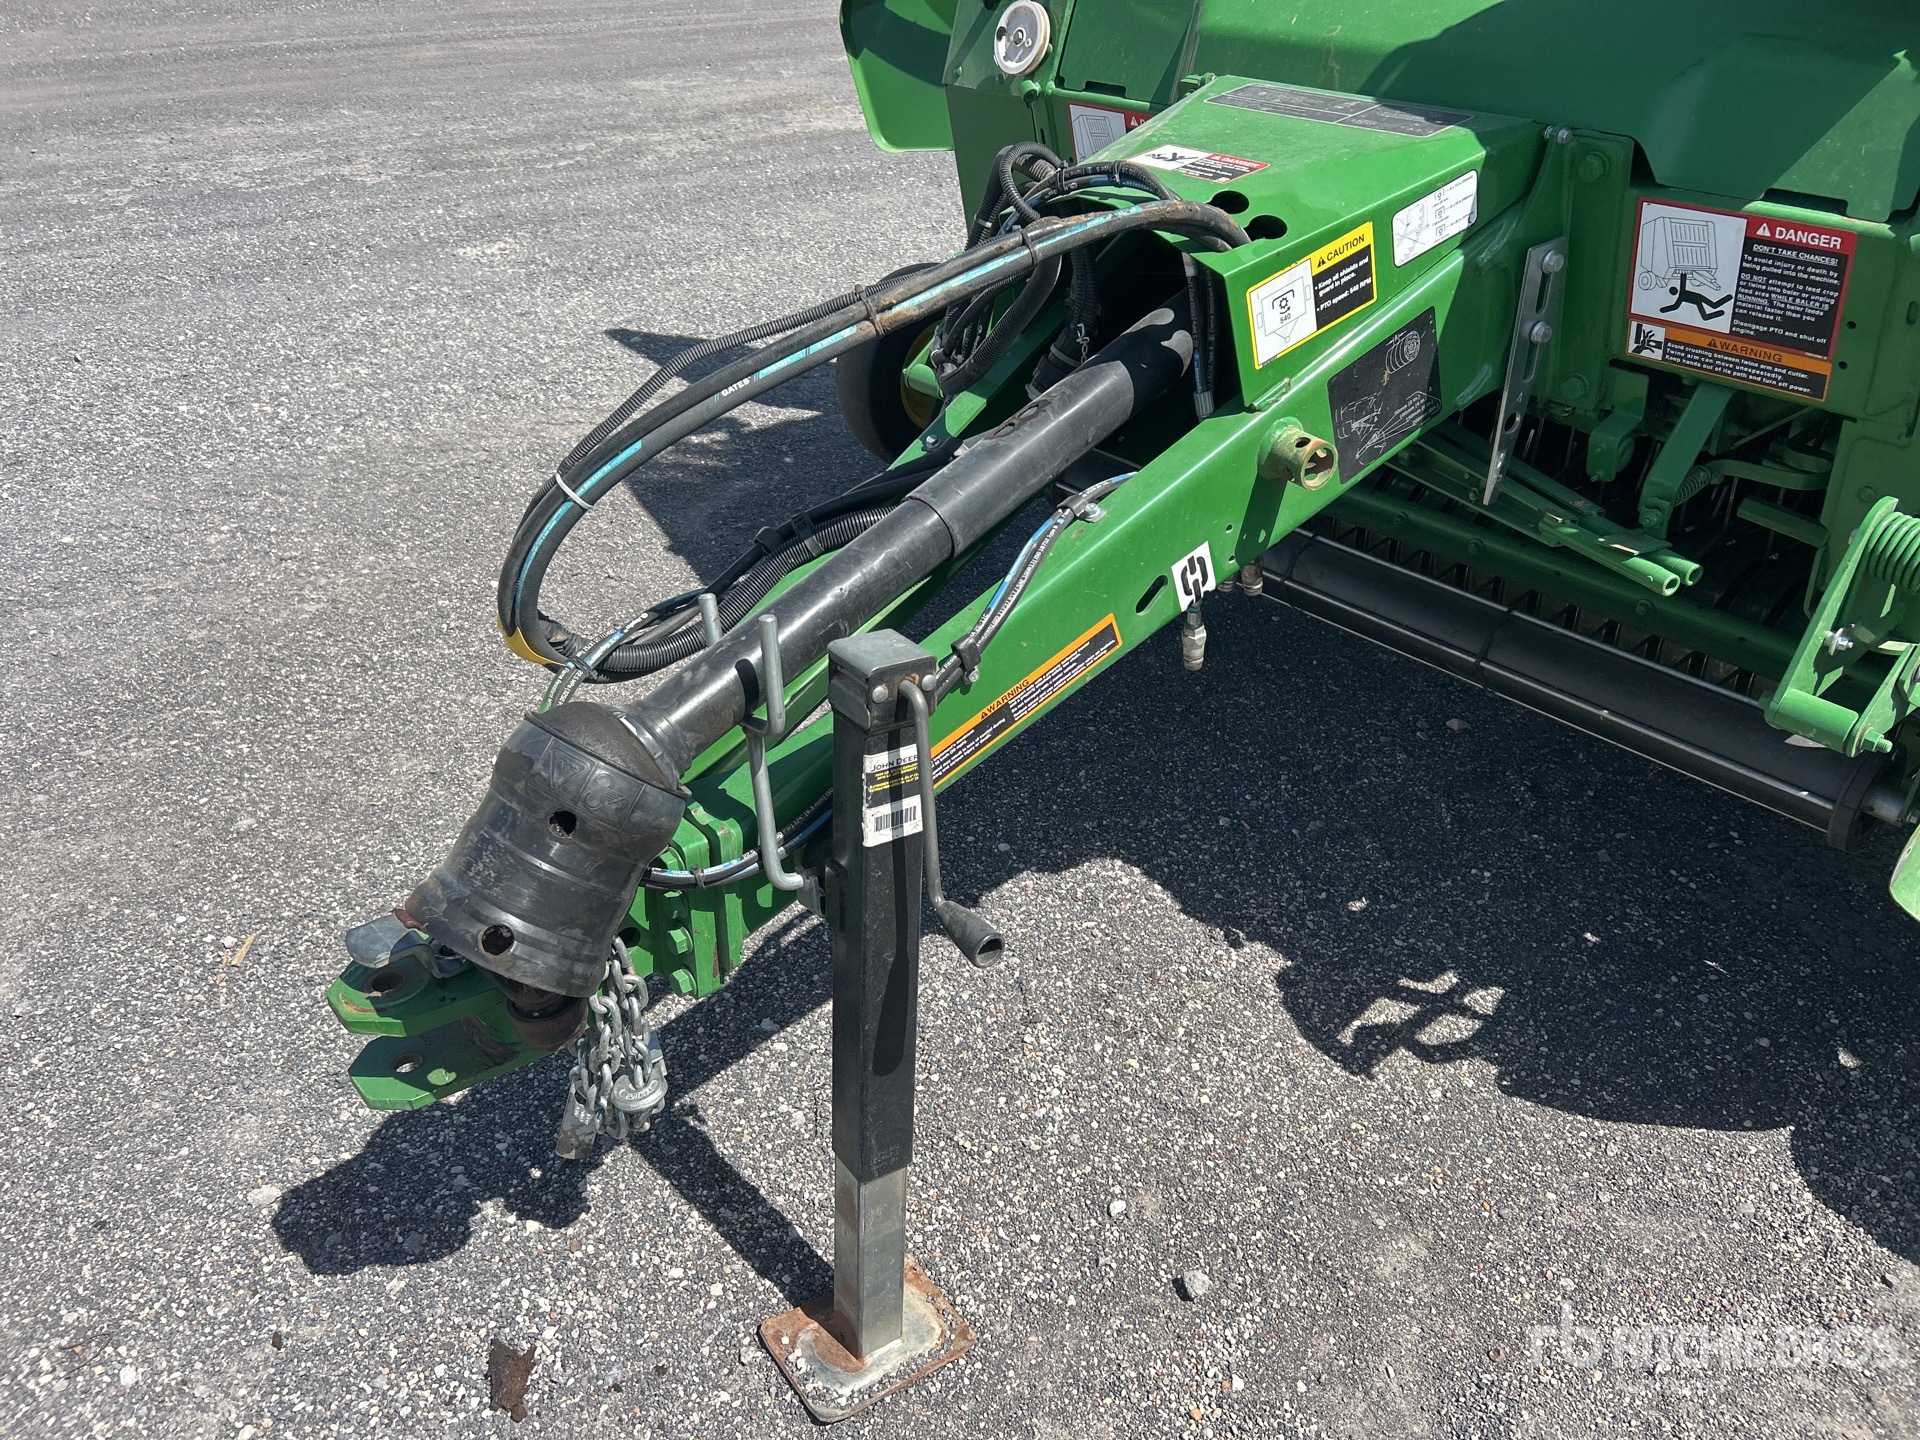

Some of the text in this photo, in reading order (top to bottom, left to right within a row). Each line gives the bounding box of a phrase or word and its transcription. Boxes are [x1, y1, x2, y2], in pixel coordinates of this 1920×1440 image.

[1326, 231, 1364, 263] CAUTION
[1774, 226, 1842, 249] DANGER
[1752, 243, 1838, 266] DON'T TAKE CHANCES!
[1753, 256, 1772, 264] avoid
[1774, 259, 1795, 269] injury
[1806, 266, 1827, 275] death
[1318, 276, 1331, 290] Keep
[1340, 260, 1358, 277] shields
[1358, 255, 1368, 266] and
[1742, 261, 1760, 270] being
[1761, 265, 1781, 274] pulled
[1320, 299, 1331, 310] PTO
[1350, 283, 1358, 294] 540
[1359, 276, 1371, 288] RPM
[1334, 278, 1340, 286] in
[1740, 272, 1750, 280] DO
[1752, 274, 1766, 284] NOT
[1768, 278, 1794, 288] attempt
[1822, 289, 1838, 297] crop
[1748, 281, 1765, 289] twine
[1810, 294, 1835, 304] unplug
[1736, 300, 1762, 310] material
[1764, 306, 1783, 314] faster
[1771, 293, 1793, 303] WHILE
[1795, 298, 1820, 309] BALER
[1786, 303, 1803, 311] baler
[1804, 307, 1823, 316] feeds
[1280, 313, 1291, 324] 540
[1733, 318, 1767, 332] Disengage
[1769, 326, 1783, 334] PTO
[1748, 309, 1773, 320] release
[1667, 342, 1683, 350] Avoid
[1685, 346, 1712, 358] crushing
[1714, 353, 1739, 363] between
[1741, 359, 1758, 367] twine
[1787, 369, 1808, 379] cutter.
[1719, 340, 1782, 363] WARNING
[1665, 355, 1680, 363] Keep
[1682, 358, 1700, 367] hands
[1732, 370, 1747, 378] path
[1789, 384, 1810, 394] power.
[1666, 348, 1684, 356] Twine
[1735, 364, 1783, 380] unexpectedly.
[986, 677, 1029, 716] WARNING
[871, 756, 918, 772] JOHN DEER
